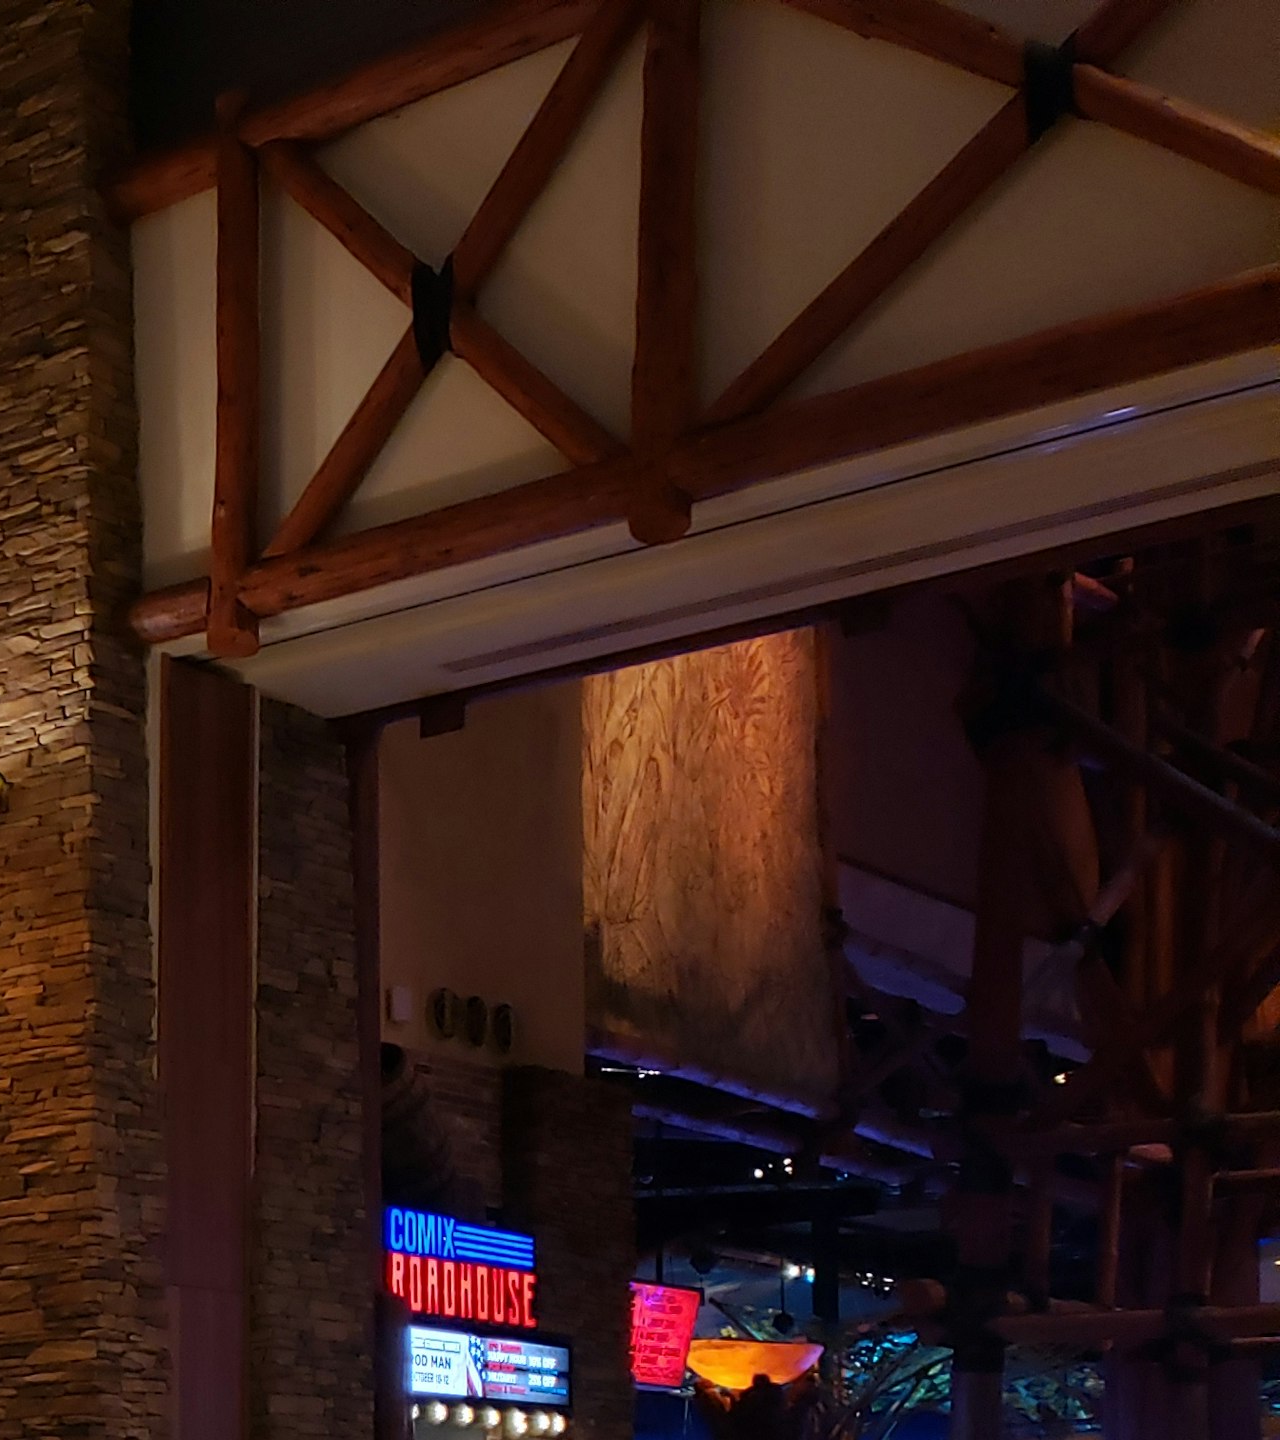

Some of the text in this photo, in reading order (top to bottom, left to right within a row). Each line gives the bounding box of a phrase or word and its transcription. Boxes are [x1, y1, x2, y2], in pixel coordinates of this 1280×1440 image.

[391, 1208, 455, 1258] COMIX
[392, 1252, 537, 1328] ROADHOUSE
[431, 1355, 452, 1371] MAN
